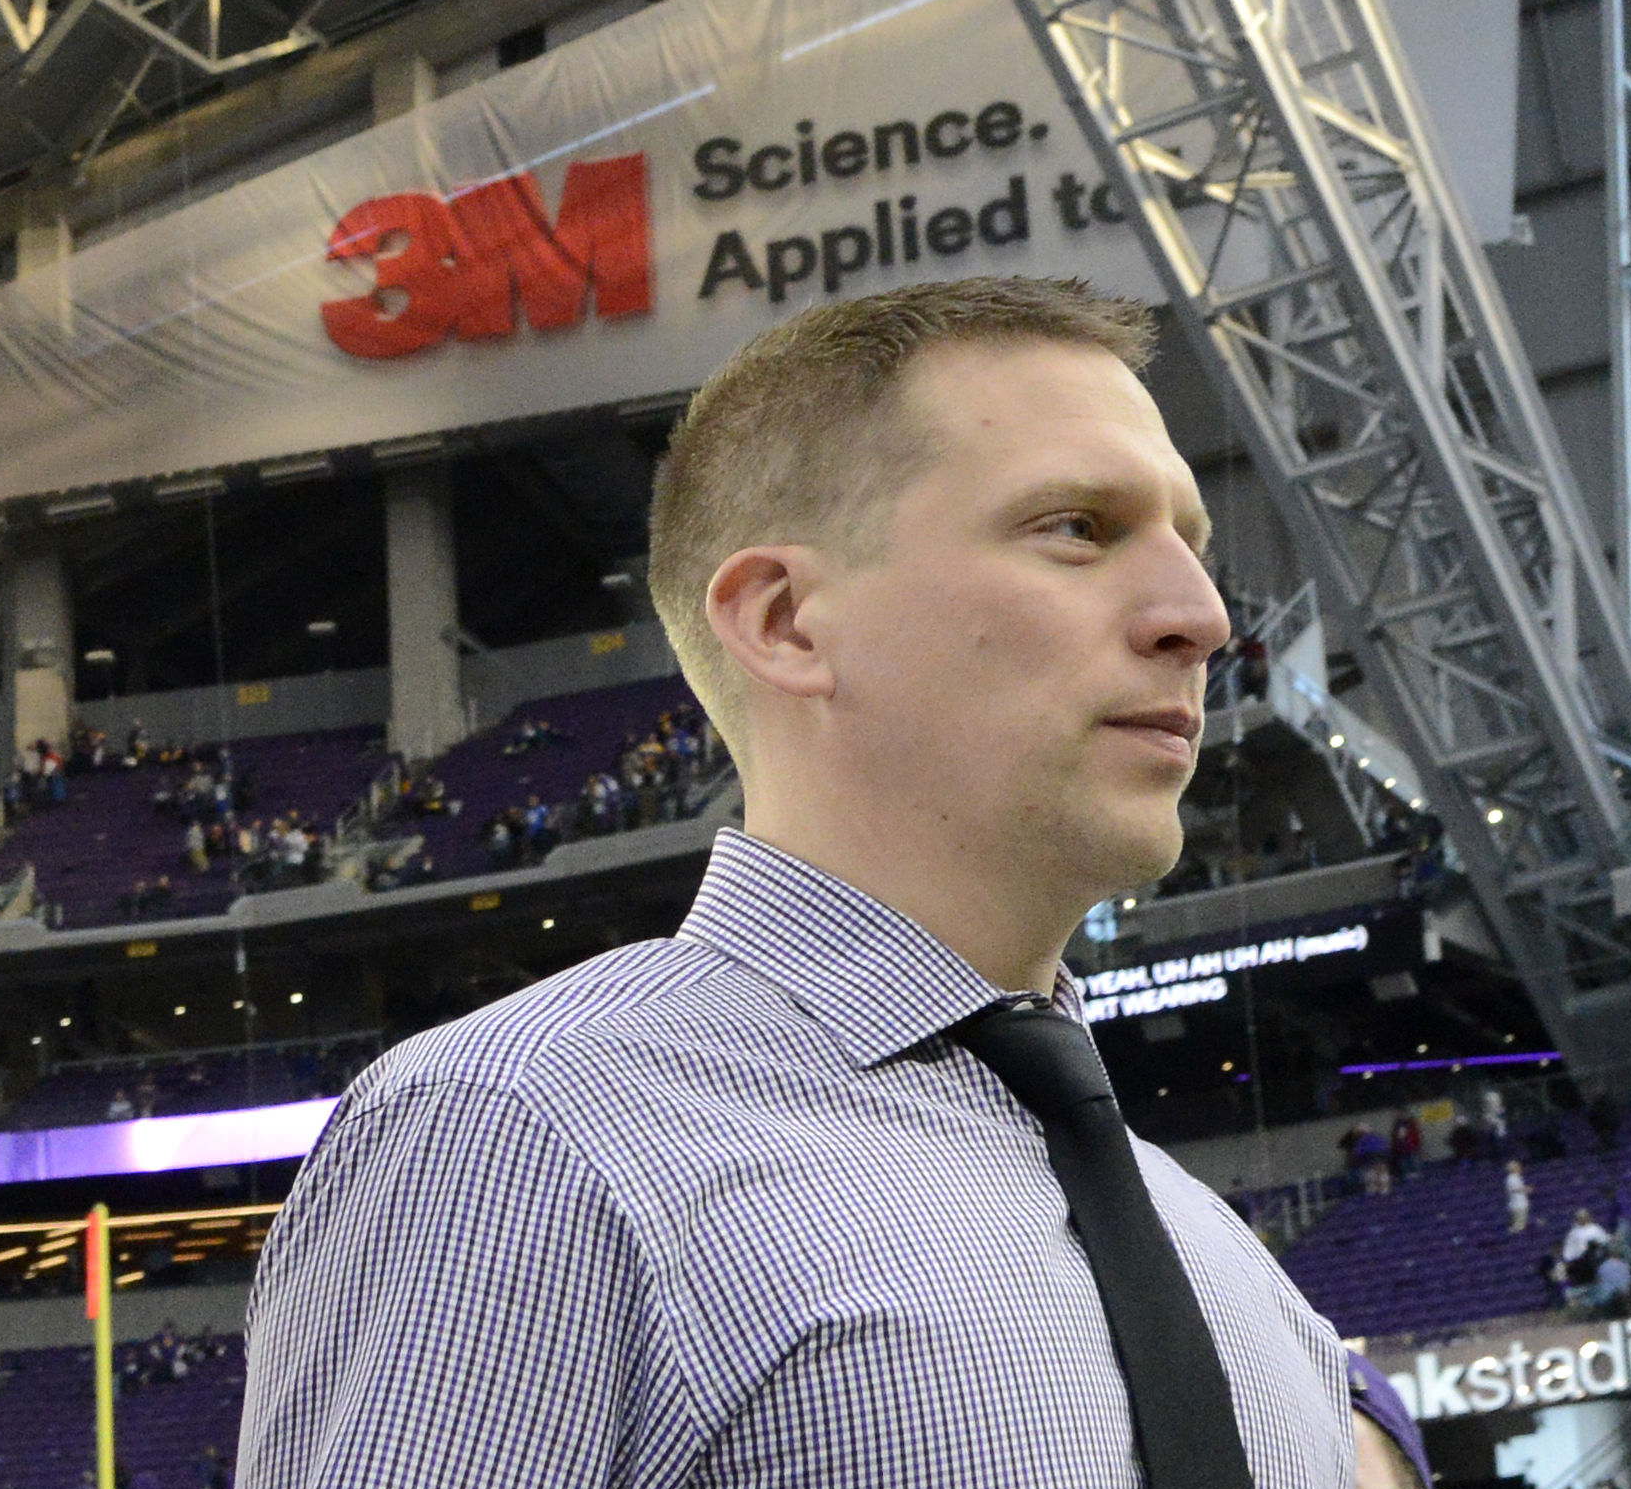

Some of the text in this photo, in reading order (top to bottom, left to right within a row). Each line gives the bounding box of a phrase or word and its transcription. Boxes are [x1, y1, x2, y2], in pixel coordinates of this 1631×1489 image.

[693, 98, 1050, 202] Science.
[320, 150, 653, 359] 3M
[697, 174, 1031, 303] Applied
